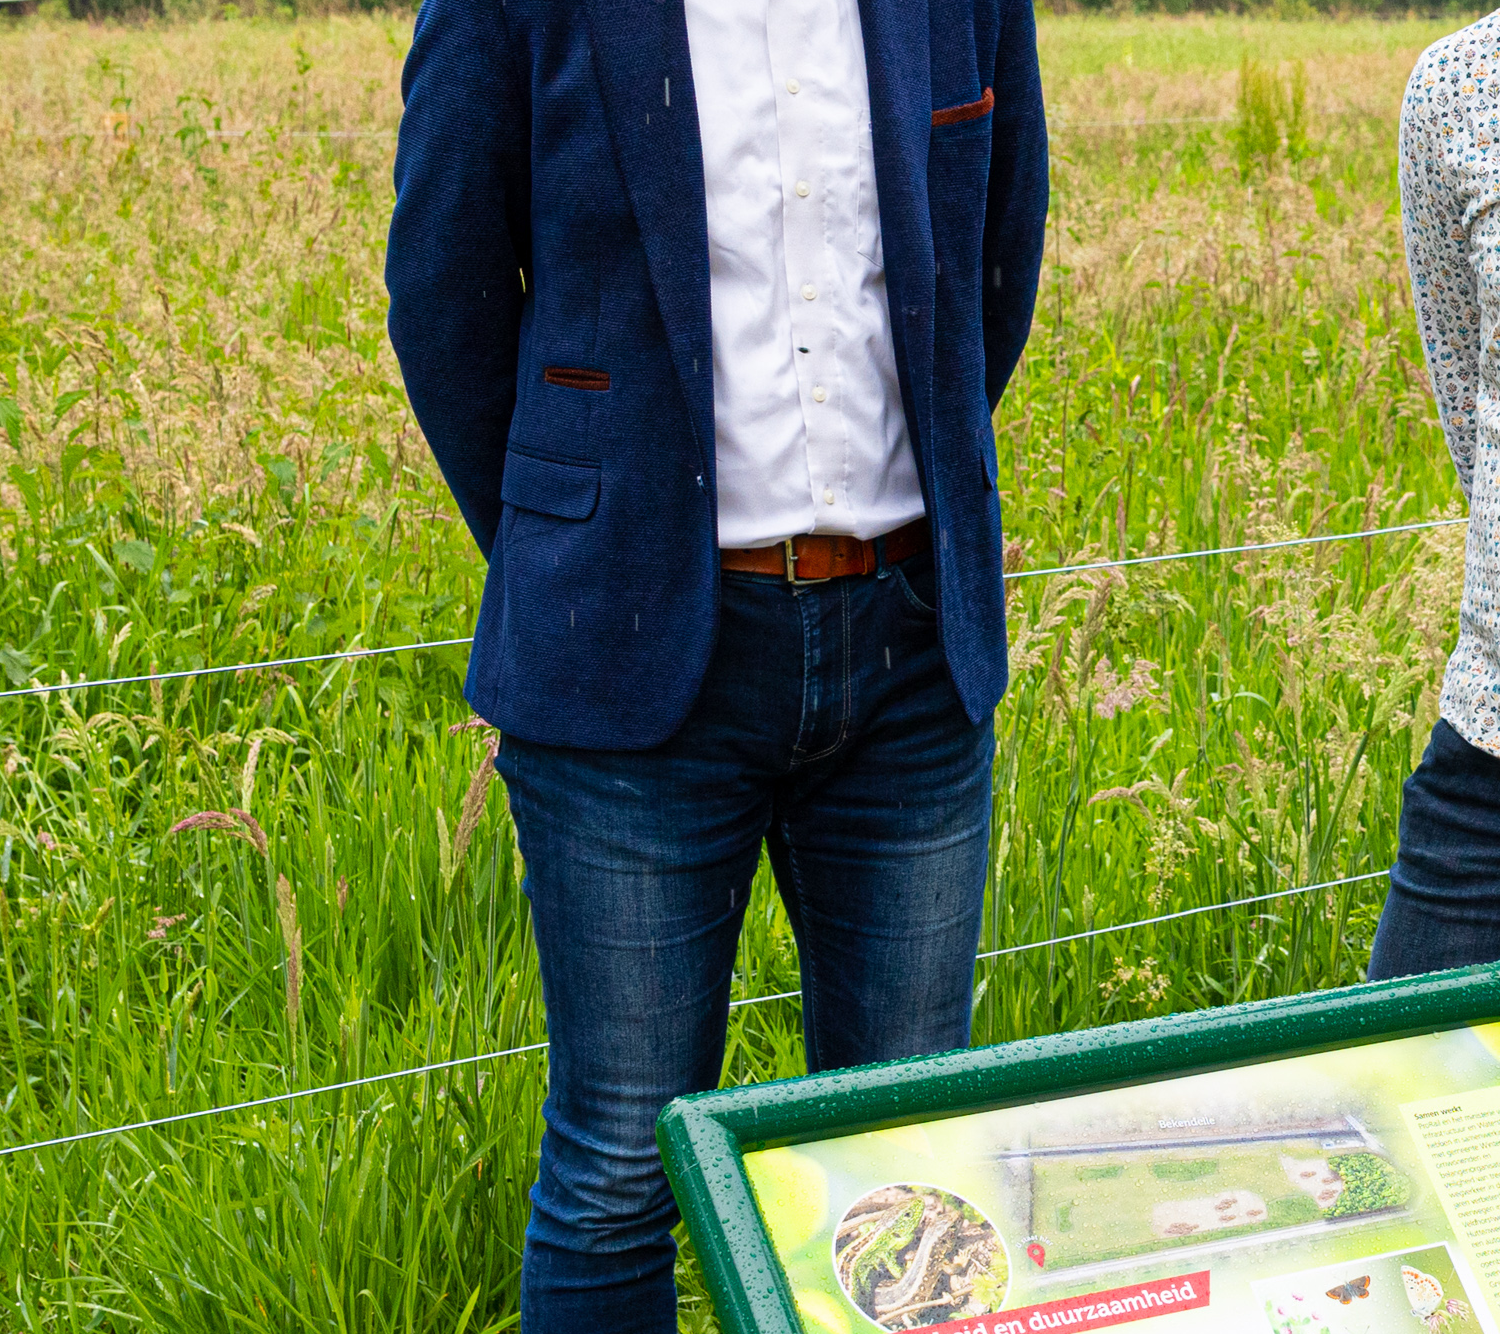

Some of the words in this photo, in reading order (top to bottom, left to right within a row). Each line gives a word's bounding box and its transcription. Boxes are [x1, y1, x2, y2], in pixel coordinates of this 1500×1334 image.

[1412, 1109, 1440, 1119] Samen
[1439, 1104, 1463, 1114] werkt
[1158, 1115, 1216, 1129] Bekendelle
[1024, 1279, 1198, 1332] duurzaamheid
